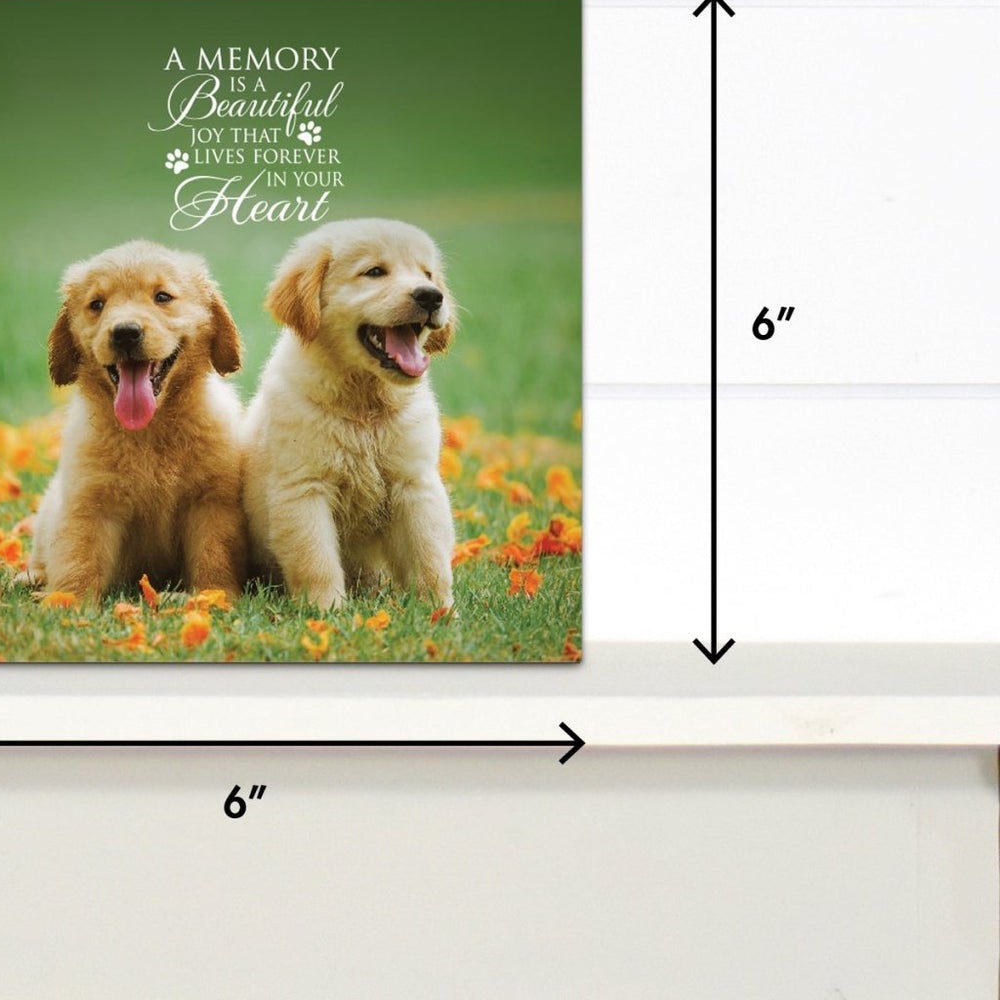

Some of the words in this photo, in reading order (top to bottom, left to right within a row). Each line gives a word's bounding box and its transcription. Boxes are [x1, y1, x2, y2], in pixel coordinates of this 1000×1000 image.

[163, 47, 186, 71] A
[196, 47, 341, 71] MEMORY
[230, 76, 246, 92] IS
[253, 76, 267, 92] A
[147, 73, 345, 137] Beautiful
[190, 127, 224, 147] JOY
[230, 127, 282, 143] THAT
[194, 148, 245, 164] LIVES
[253, 148, 342, 164] FOREVER
[266, 171, 287, 187] IN
[292, 171, 345, 187] YOUR
[169, 168, 332, 232] Heart
